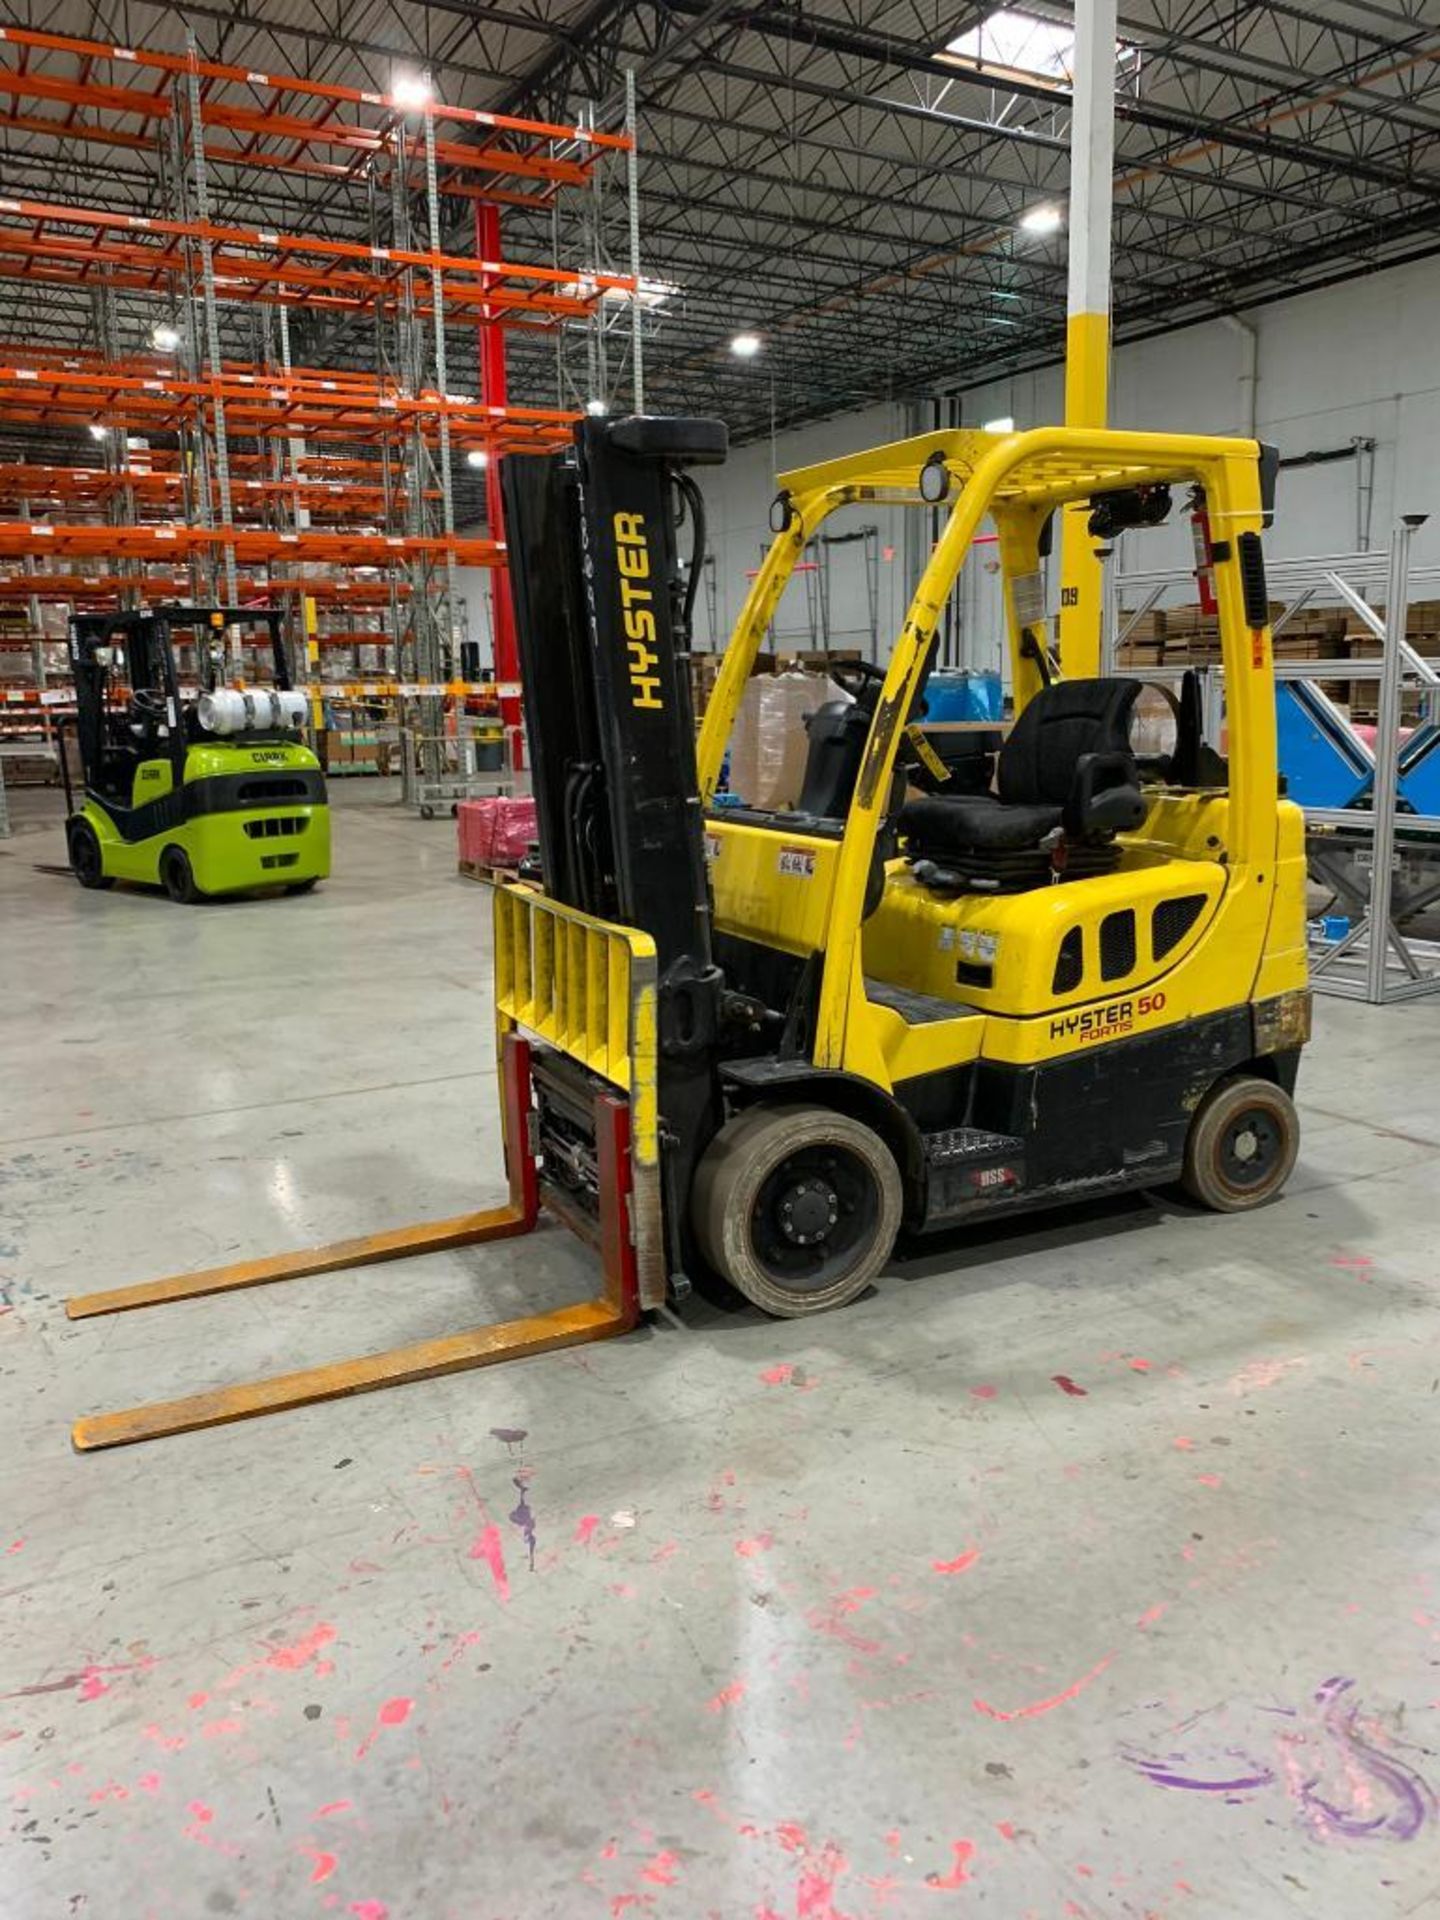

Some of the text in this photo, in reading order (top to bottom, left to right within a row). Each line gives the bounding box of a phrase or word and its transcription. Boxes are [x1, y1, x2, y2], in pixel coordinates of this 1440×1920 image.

[614, 511, 664, 709] HYSTER
[1050, 992, 1166, 1039] HYSTER 50
[1079, 1020, 1133, 1043] FORTIS
